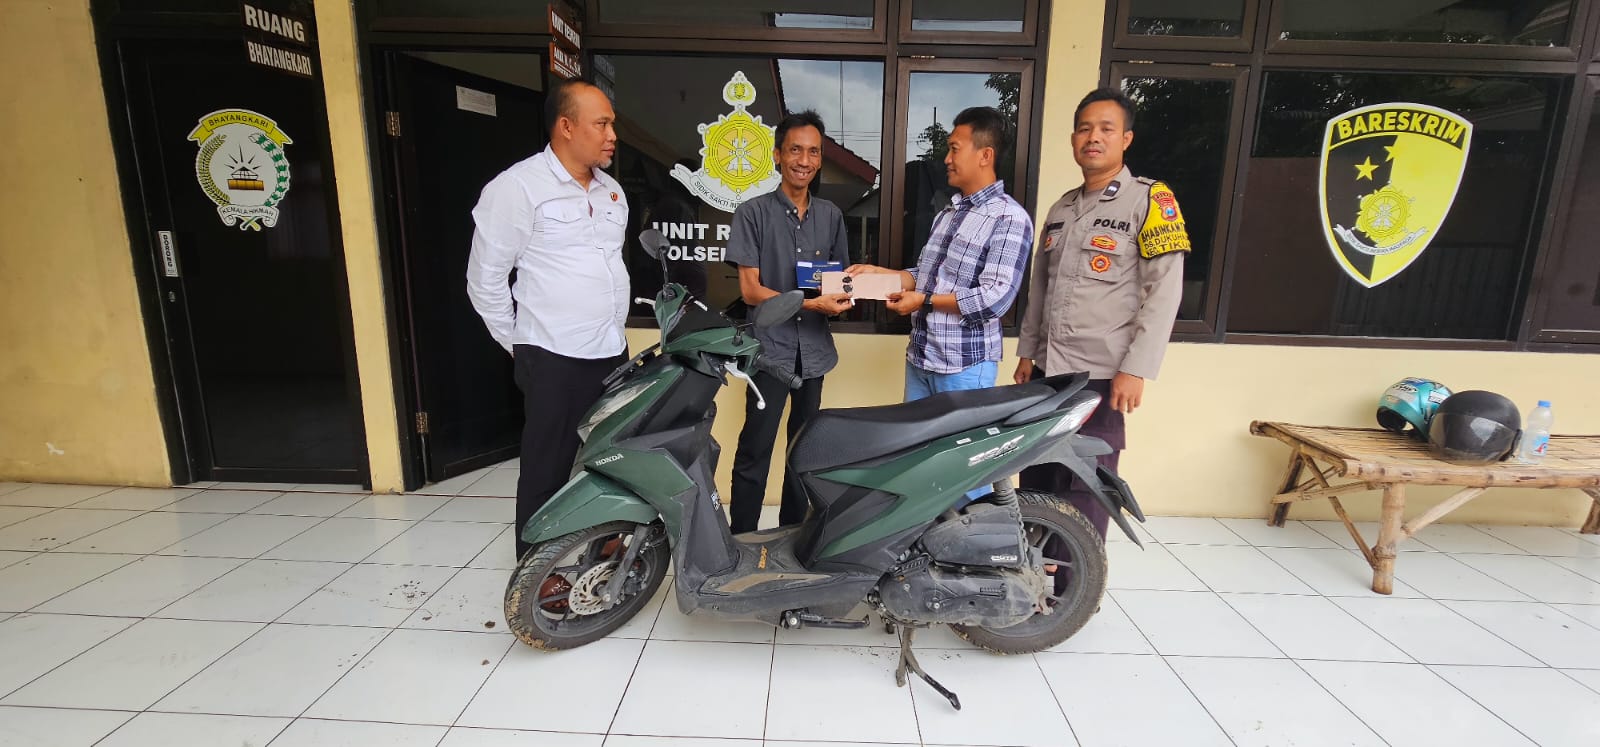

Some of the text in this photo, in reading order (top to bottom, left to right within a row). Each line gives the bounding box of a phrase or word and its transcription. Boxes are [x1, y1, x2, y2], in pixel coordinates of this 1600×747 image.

[244, 4, 305, 42] RUANG
[247, 41, 312, 76] BHAYANGKARI
[208, 114, 269, 128] BHAYANGKARI
[1337, 111, 1466, 144] BARESKRIM
[652, 221, 709, 240] UNIT
[1093, 218, 1131, 233] POLRI
[667, 245, 727, 262] OLSE
[594, 453, 625, 466] HONDA
